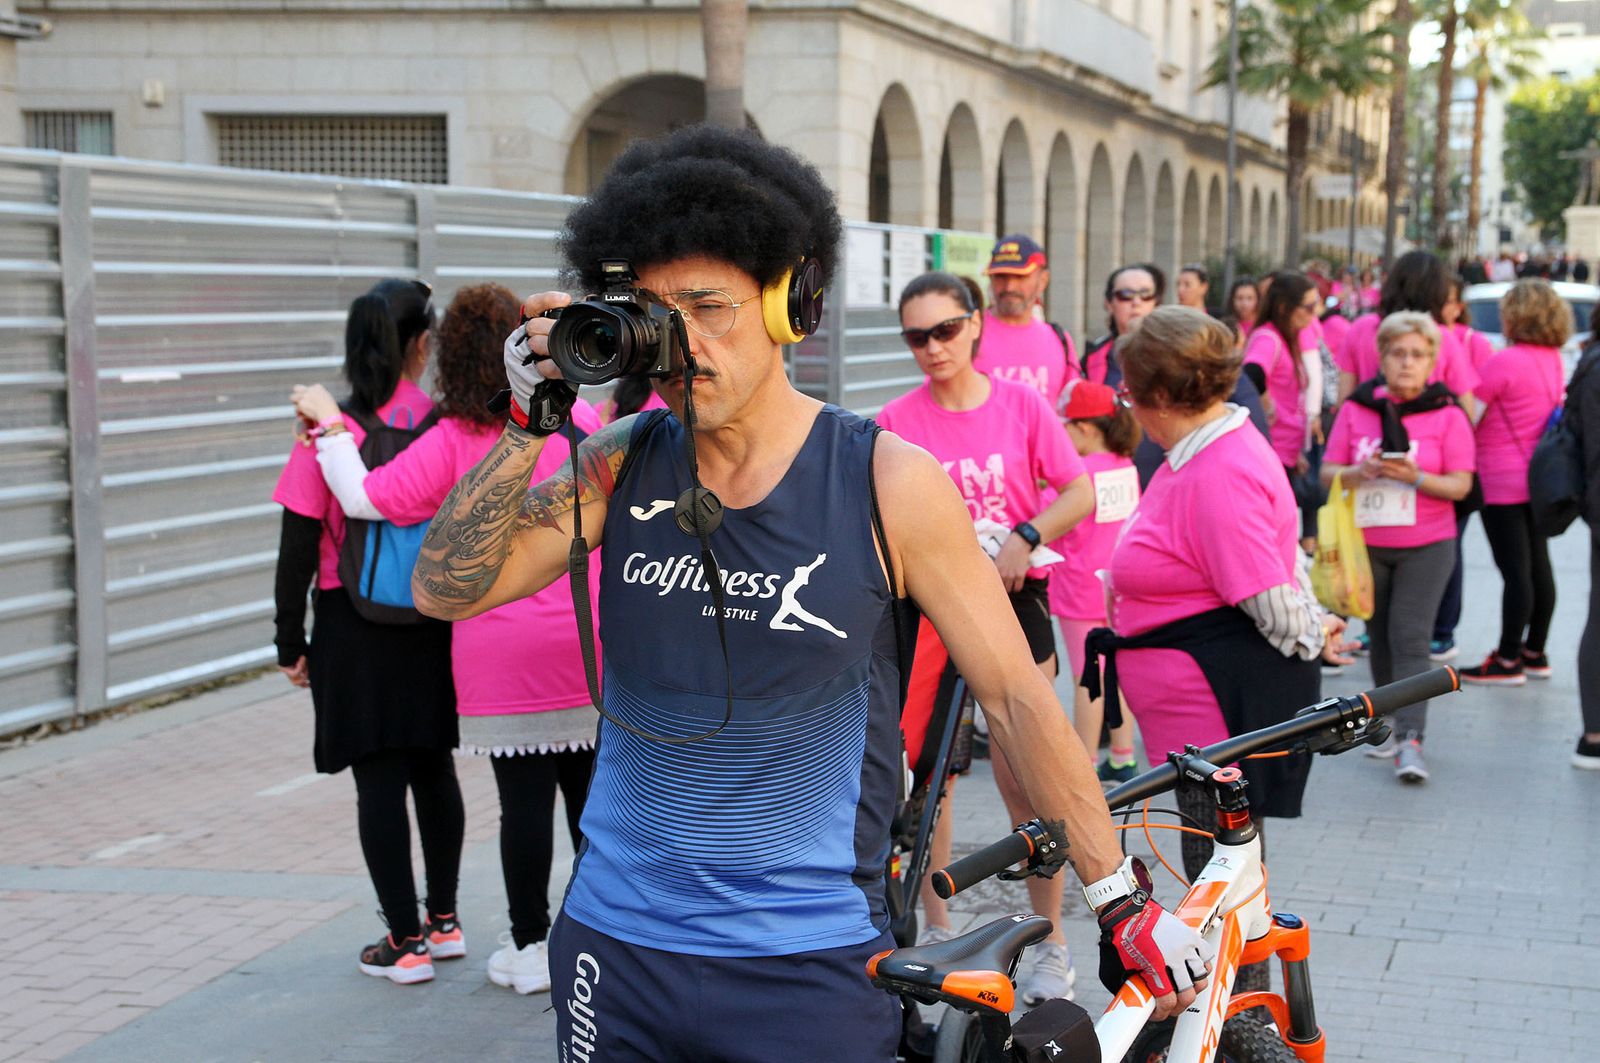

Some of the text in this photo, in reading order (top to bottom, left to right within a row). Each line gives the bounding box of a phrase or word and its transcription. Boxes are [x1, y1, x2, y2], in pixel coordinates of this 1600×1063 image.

[605, 294, 630, 302] LUMIX
[466, 446, 513, 498] INVENCIBLE
[941, 452, 1005, 498] M
[701, 604, 759, 621] LISTYLE
[977, 990, 999, 1005] KTM
